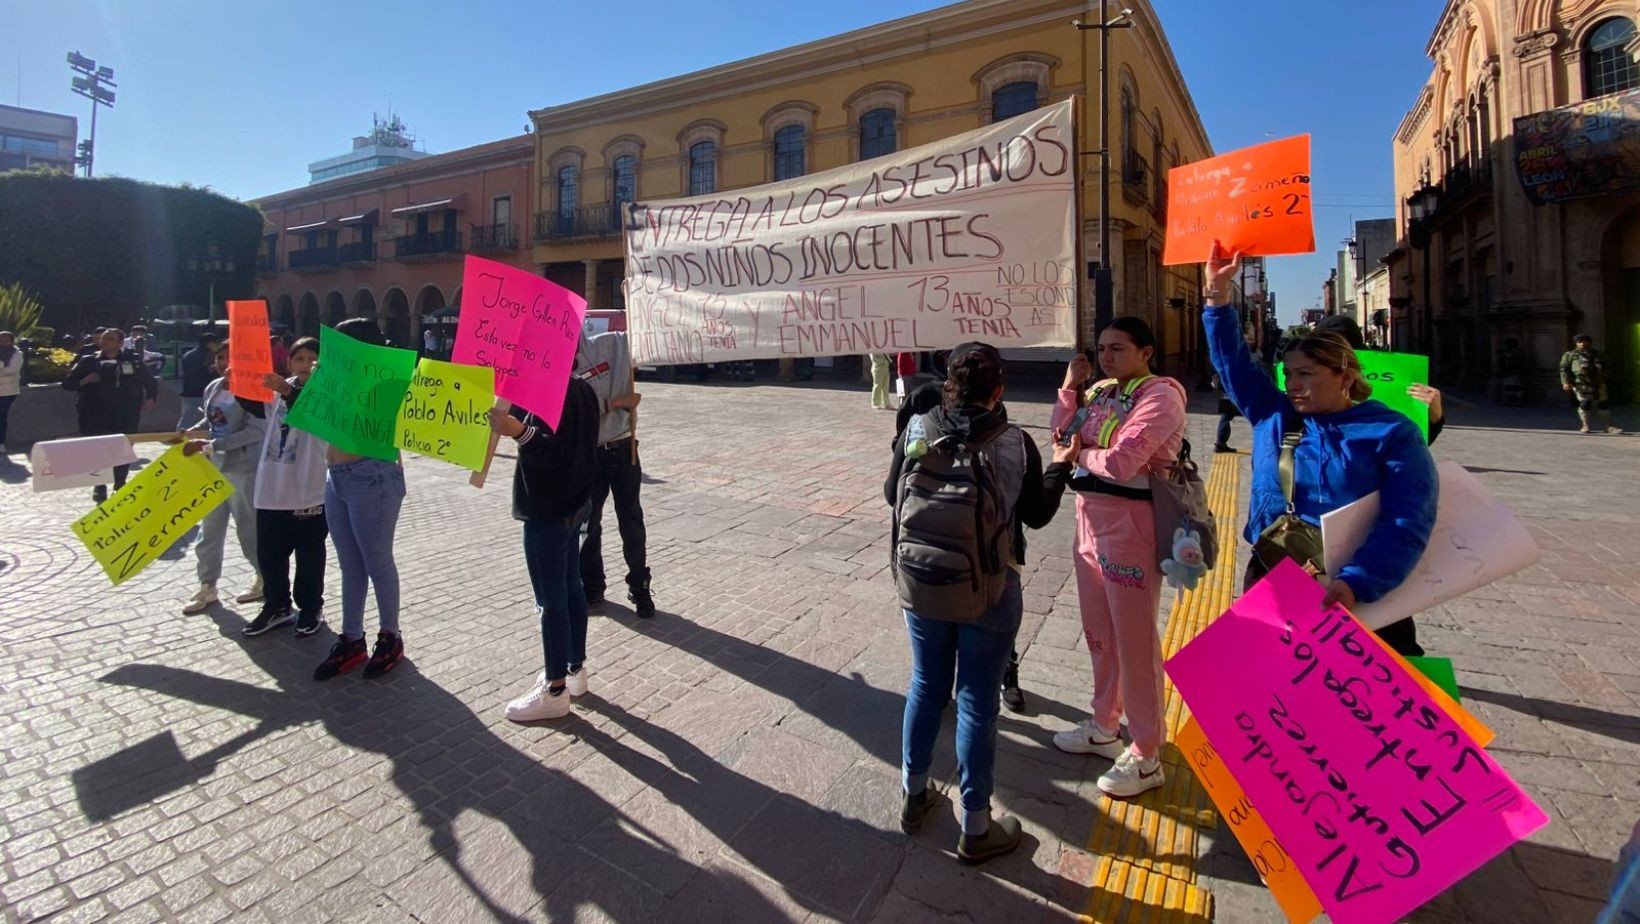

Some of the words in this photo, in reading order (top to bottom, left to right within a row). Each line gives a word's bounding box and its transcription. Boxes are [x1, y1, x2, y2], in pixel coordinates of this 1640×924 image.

[1519, 145, 1559, 161] ABRIL
[627, 197, 751, 248] ENTREGA
[752, 195, 776, 231] A
[780, 184, 849, 227] LOS
[856, 125, 1068, 210] ASESINOS
[656, 251, 707, 293] DOS
[798, 213, 1005, 281] INOCENTES
[998, 263, 1025, 286] NO
[478, 272, 527, 319] Jorge
[742, 300, 763, 349] Y
[782, 284, 884, 324] ANGEL
[907, 275, 950, 313] 13
[778, 317, 937, 356] EMMANUEL
[952, 317, 1022, 339] TENIA
[523, 348, 537, 361] no
[541, 350, 551, 370] lo
[402, 390, 437, 421] Pablo
[442, 399, 490, 427] Aviles
[402, 428, 432, 453] Policia
[79, 483, 144, 535] Entrega
[154, 460, 169, 478] al
[92, 507, 152, 551] Policia
[109, 478, 225, 580] Zermeño
[1268, 692, 1422, 879] Gutierrez
